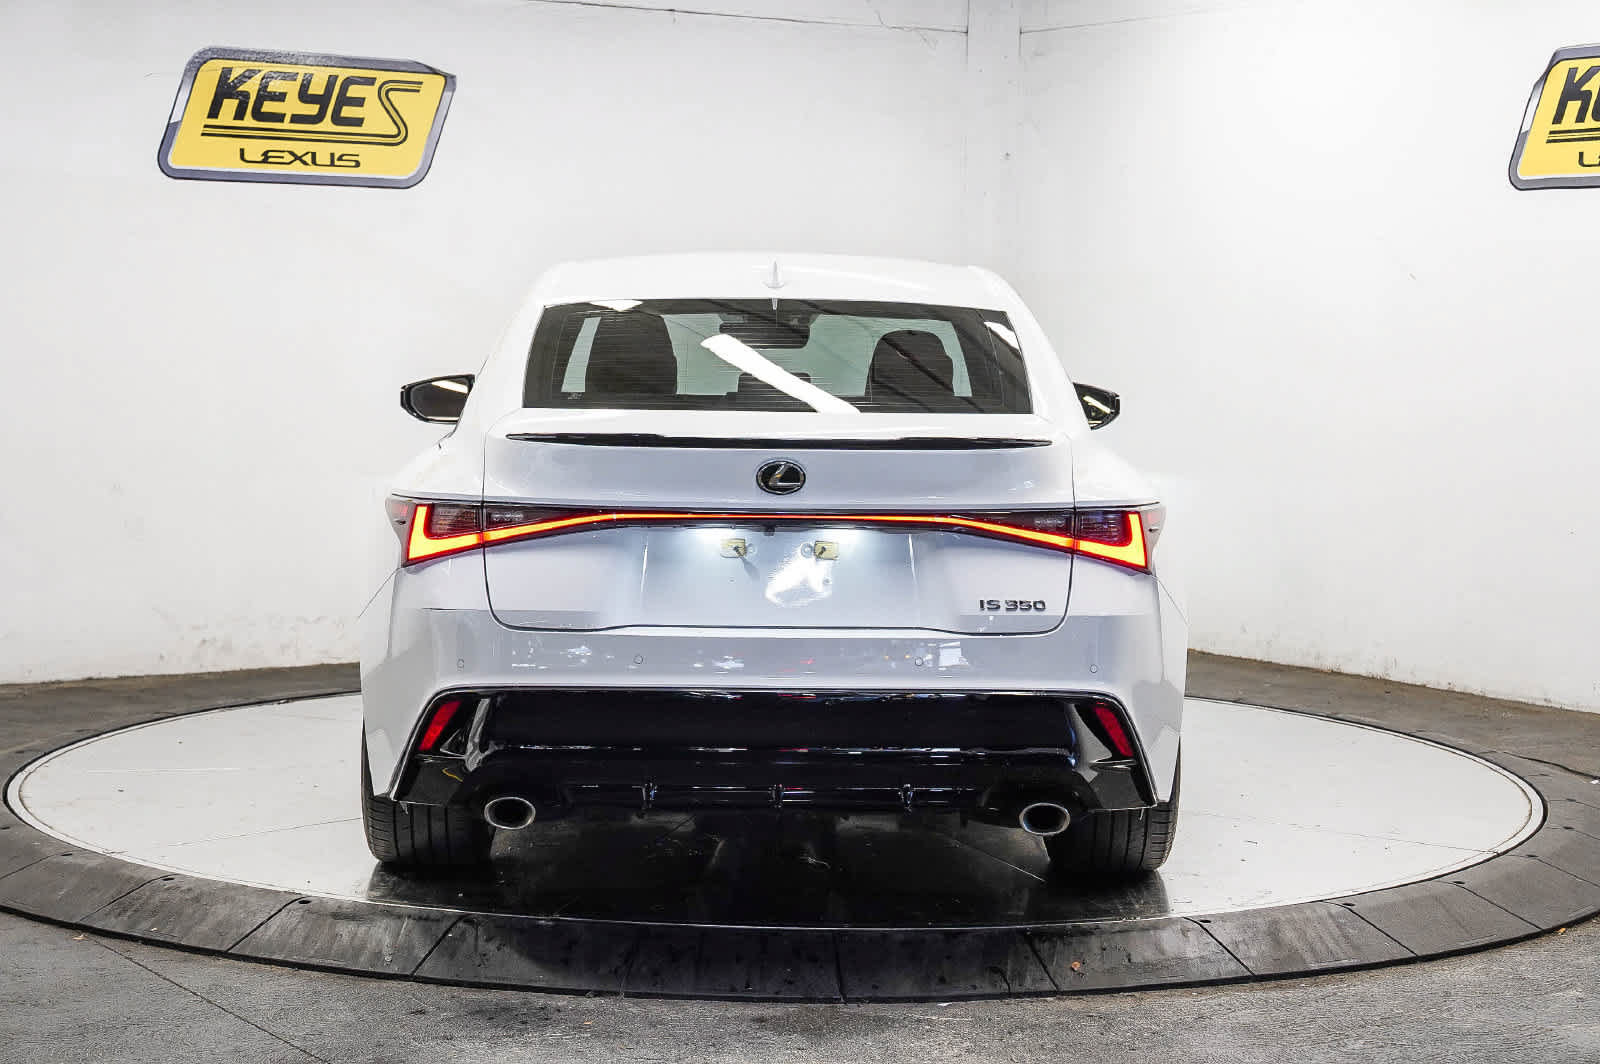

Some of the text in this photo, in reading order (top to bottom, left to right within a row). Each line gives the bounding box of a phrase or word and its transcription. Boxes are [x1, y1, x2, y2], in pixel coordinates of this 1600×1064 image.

[202, 67, 423, 146] KEYES
[1552, 66, 1600, 124] K
[239, 148, 361, 168] LEXUS
[979, 599, 1046, 611] IS 350
